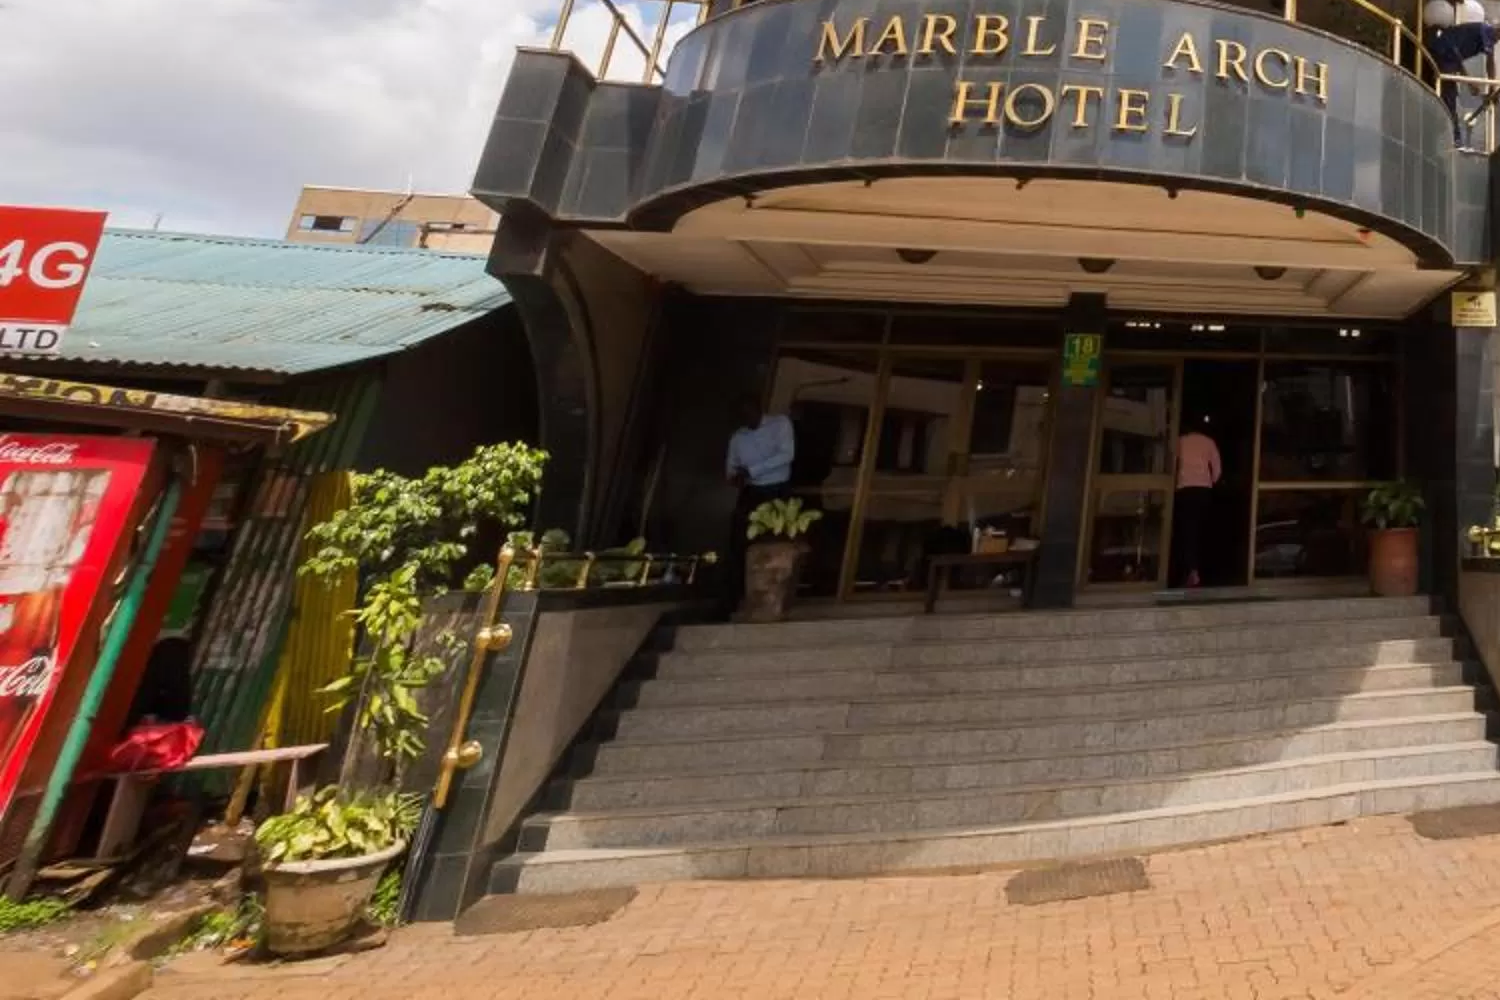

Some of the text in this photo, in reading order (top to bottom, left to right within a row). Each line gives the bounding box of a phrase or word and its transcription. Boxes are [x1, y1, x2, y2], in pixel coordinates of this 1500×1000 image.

[812, 13, 1329, 103] MARBLE ARCH
[948, 81, 1197, 137] HOTEL
[0, 238, 89, 289] 4G
[0, 328, 60, 350] LTD
